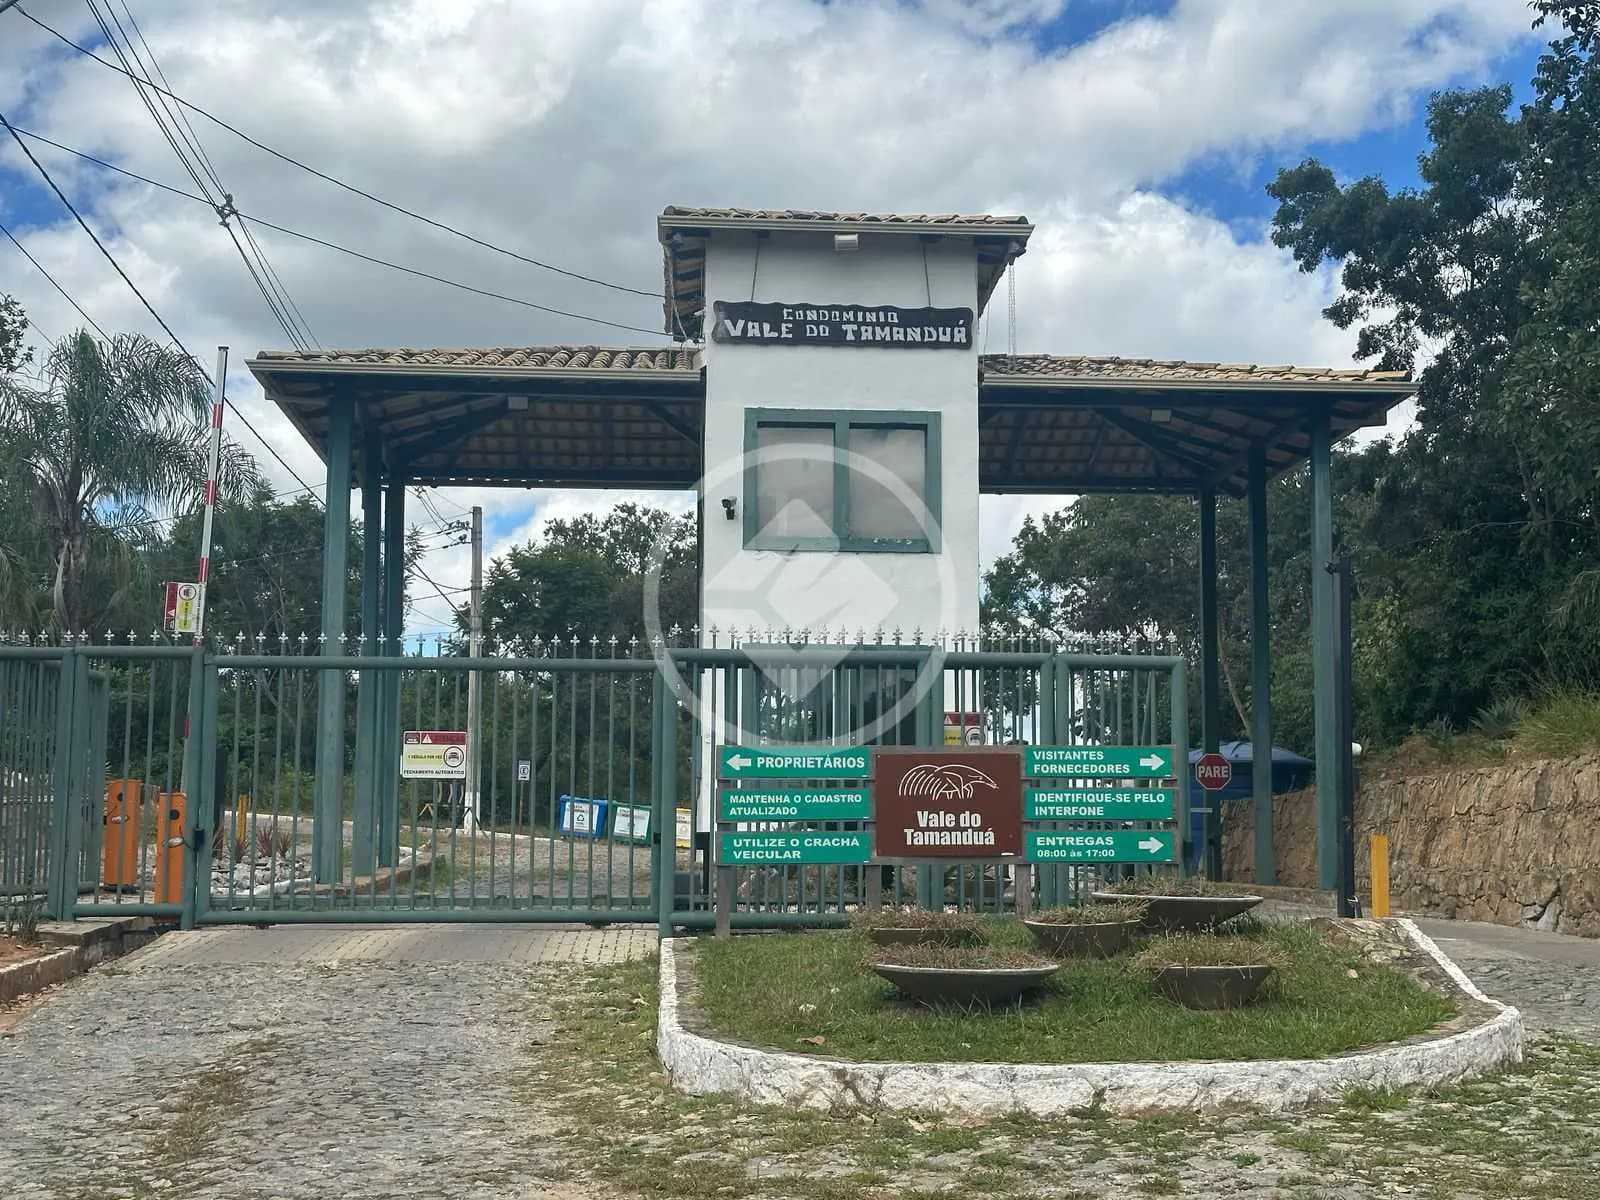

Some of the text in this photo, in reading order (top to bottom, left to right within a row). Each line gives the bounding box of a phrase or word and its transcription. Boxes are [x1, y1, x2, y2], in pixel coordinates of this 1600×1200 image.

[724, 319, 967, 344] VALE DO TAMANDUÁ
[1033, 751, 1104, 760] VISITANTES
[757, 754, 865, 769] PROPRIETÁRIOS
[1034, 764, 1130, 774] FORNECEDORES
[1197, 765, 1229, 778] PARE
[730, 794, 862, 804] MANTENHA O CADASTRO
[1035, 793, 1165, 803] IDENTIFIQUE-SE PELO
[729, 807, 798, 815] ATUALIZADO
[1035, 806, 1104, 816] INTERFONE
[917, 810, 981, 827] Vale do
[904, 827, 995, 845] Tamanduá
[1036, 836, 1114, 846] ENTREGAS
[733, 836, 860, 847] UTILIZE O CRACHÁ
[733, 850, 801, 859] VEICULAR
[1037, 849, 1115, 858] 08:00 às 17:00
